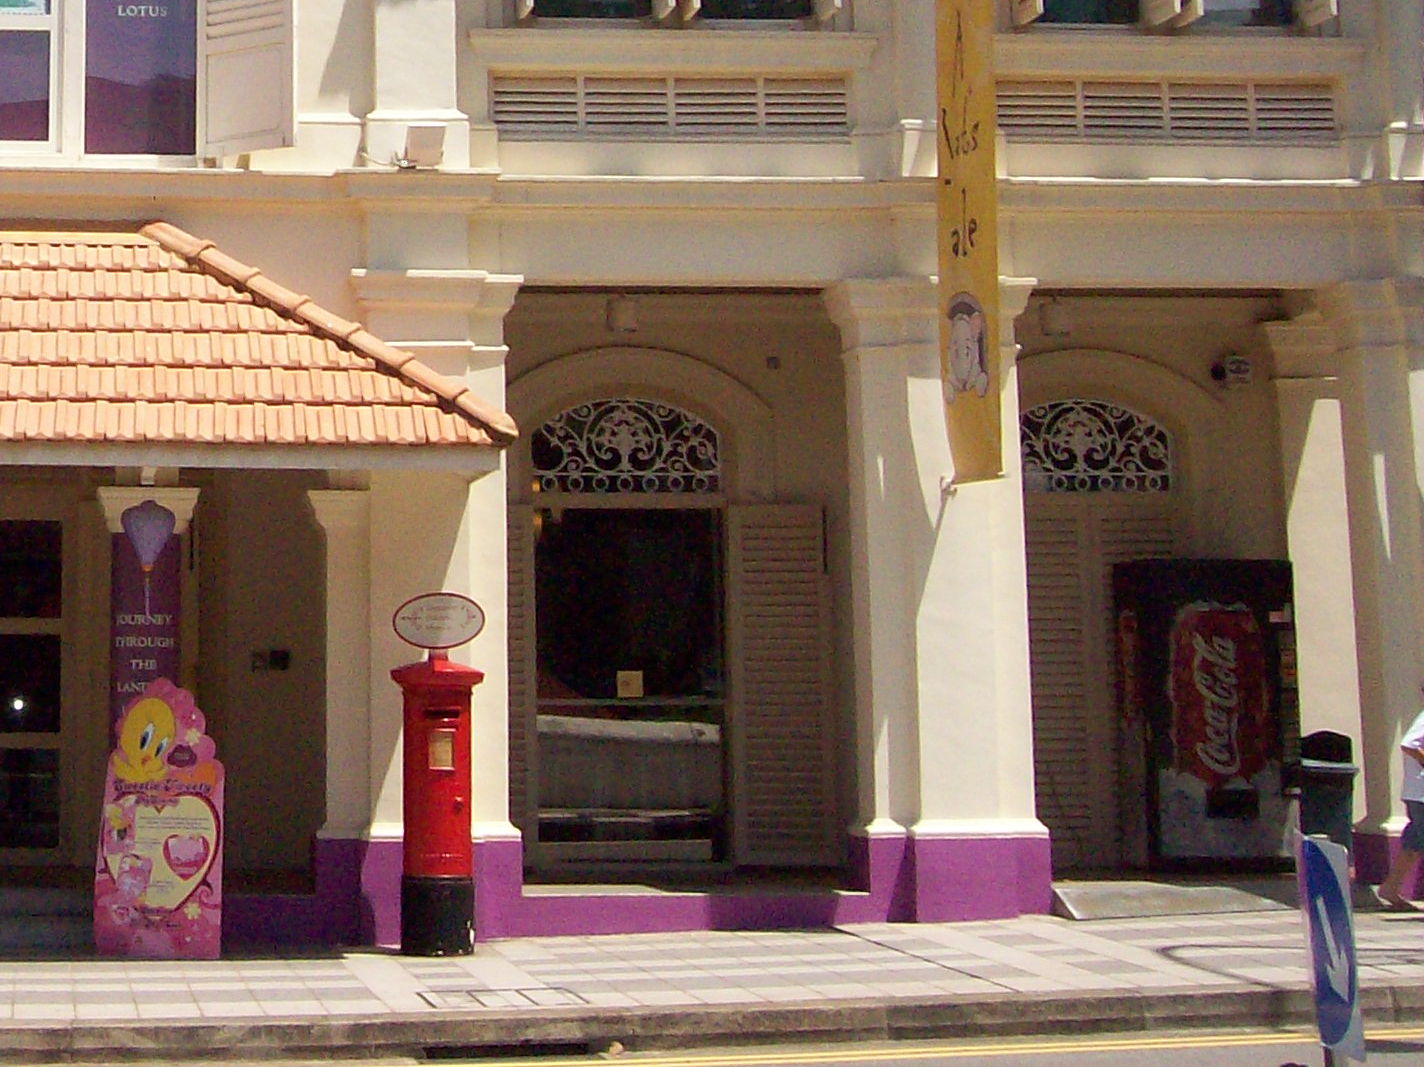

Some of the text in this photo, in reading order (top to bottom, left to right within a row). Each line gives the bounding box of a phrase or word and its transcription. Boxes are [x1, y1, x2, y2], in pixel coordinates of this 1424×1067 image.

[117, 5, 169, 18] LOTUS
[116, 636, 175, 649] THROUGH
[129, 659, 157, 671] THE
